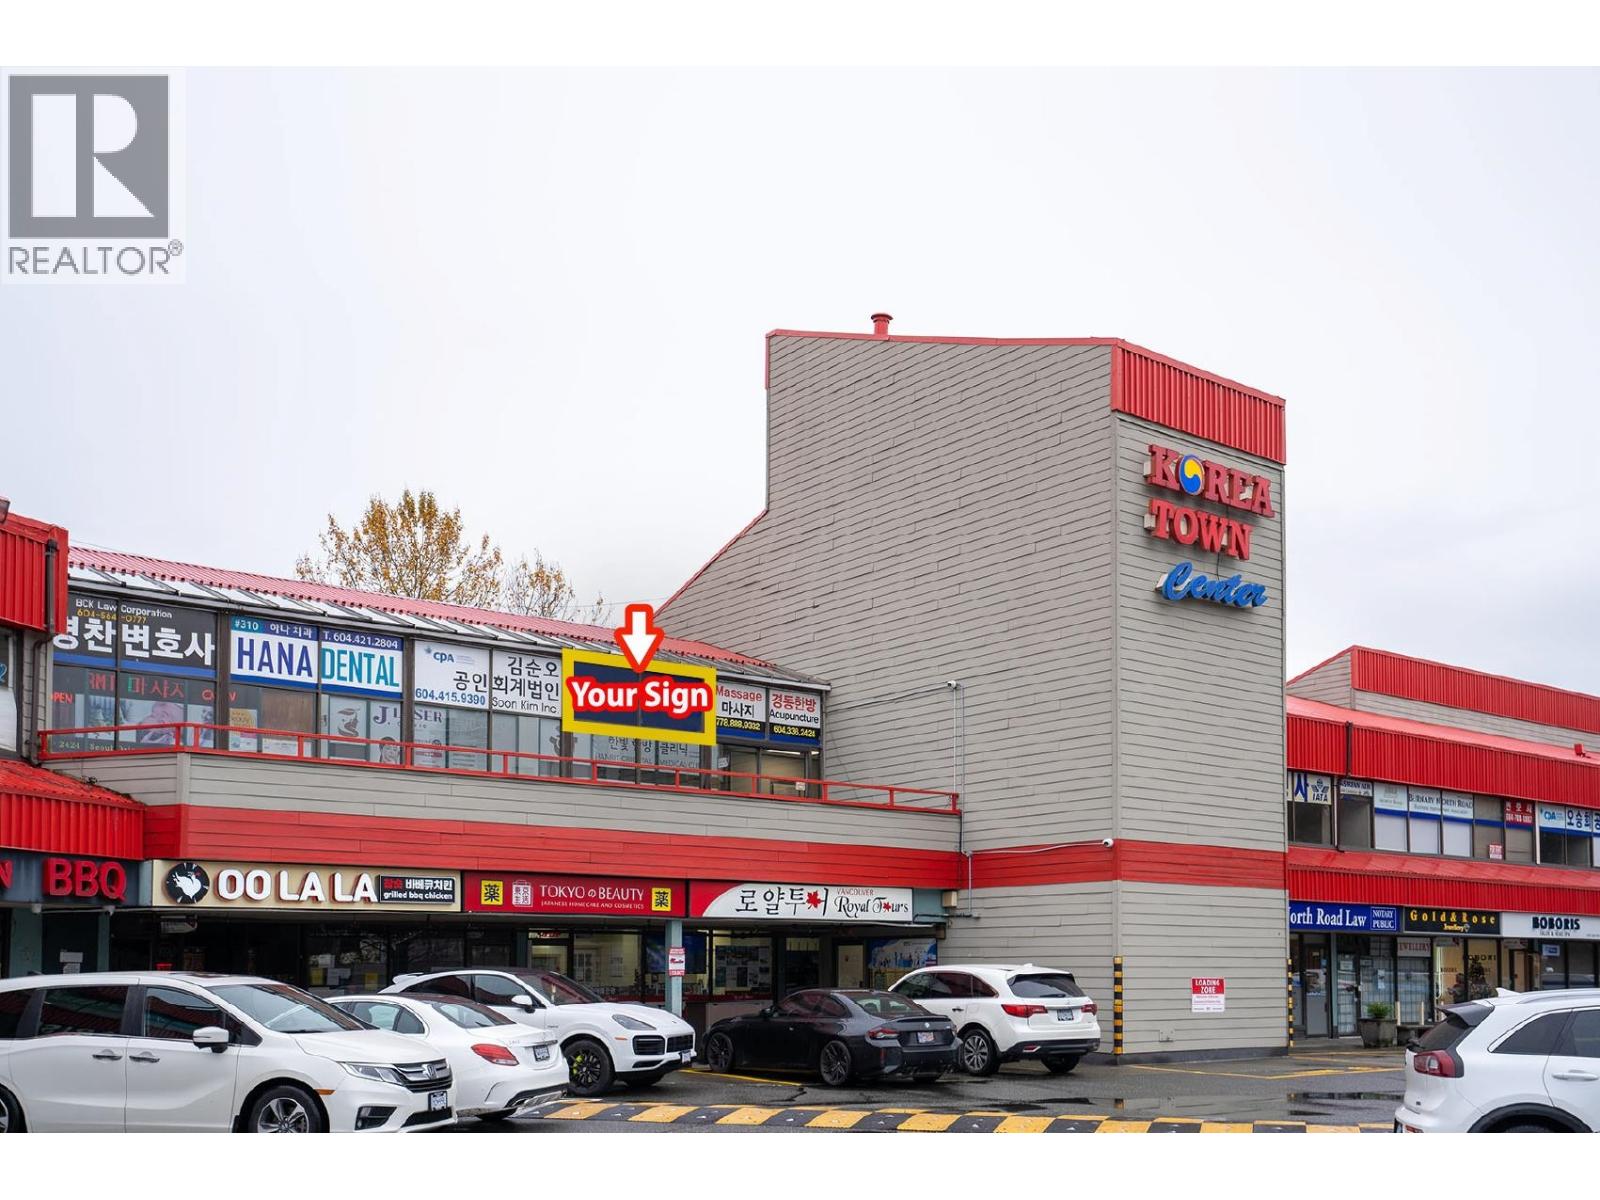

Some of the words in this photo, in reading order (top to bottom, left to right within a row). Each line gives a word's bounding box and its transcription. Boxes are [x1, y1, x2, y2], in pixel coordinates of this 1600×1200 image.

[1149, 444, 1275, 518] KOREA
[1149, 498, 1253, 561] TOWN
[1162, 561, 1268, 608] Center
[76, 599, 93, 608] BCK
[98, 601, 117, 612] Law
[120, 604, 172, 620] Corporation
[234, 620, 259, 631] #310
[292, 625, 312, 639] 치과
[122, 624, 215, 666] 변호사
[237, 637, 313, 678] HANA
[321, 647, 400, 688] DENTAL
[507, 656, 560, 678] 김순오
[453, 671, 487, 693] 공인
[492, 675, 559, 702] 회계법인
[716, 685, 762, 702] Massage
[492, 697, 517, 709] Soon
[521, 700, 539, 712] Kim
[721, 701, 755, 718] 마사지
[769, 709, 819, 725] Acupuncture
[44, 857, 127, 904] BBQ
[383, 890, 408, 900] grilled
[408, 891, 424, 901] bbq
[424, 891, 453, 901] chicken
[540, 884, 585, 899] TOKYO
[598, 886, 645, 901] BEAUTY
[836, 887, 874, 897] VANCOUVER
[833, 896, 869, 919] Royal
[1372, 909, 1393, 919] NOTARY
[1288, 906, 1313, 925] orth
[1316, 908, 1343, 926] Road
[1345, 909, 1367, 928] Law
[1372, 919, 1394, 930] PUBLIC
[1532, 916, 1580, 931] BOBORIS
[1195, 979, 1220, 987] LOADING
[1200, 986, 1216, 994] ZONE
